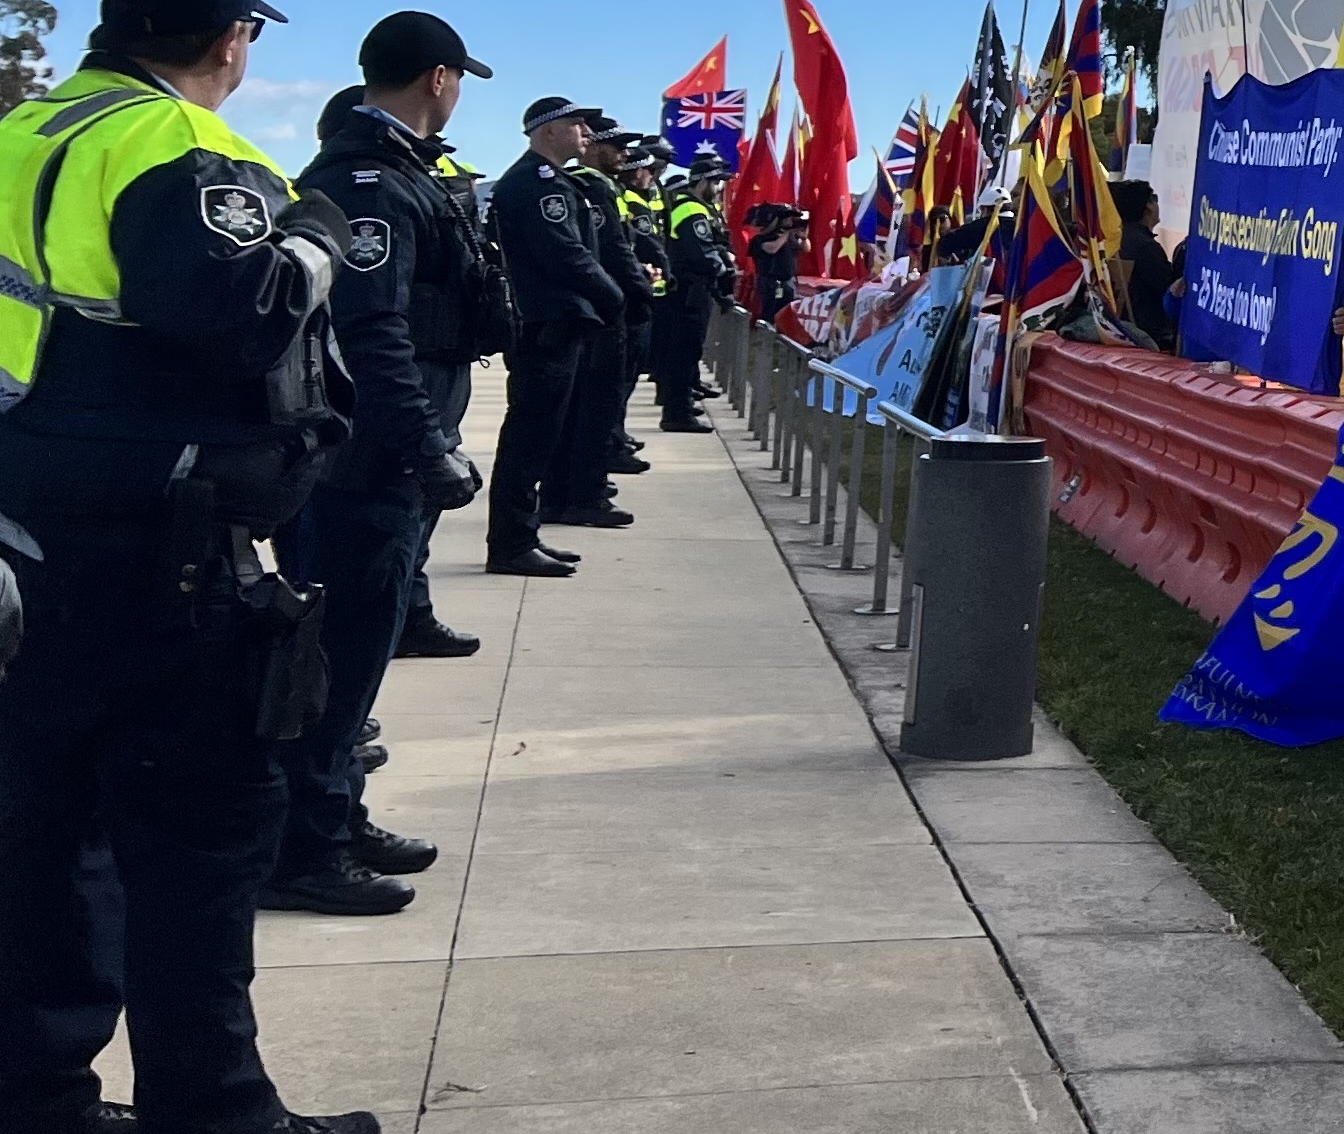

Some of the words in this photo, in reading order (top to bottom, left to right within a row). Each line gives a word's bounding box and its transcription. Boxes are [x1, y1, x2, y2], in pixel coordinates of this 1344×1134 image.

[1241, 119, 1310, 167] Communist
[1199, 195, 1218, 251] Stop
[1218, 207, 1273, 266] persecuting
[1301, 207, 1338, 276] Gong
[1197, 266, 1212, 307] 25
[1210, 270, 1233, 322] Years
[1233, 282, 1248, 327] too
[1249, 283, 1277, 346] long!
